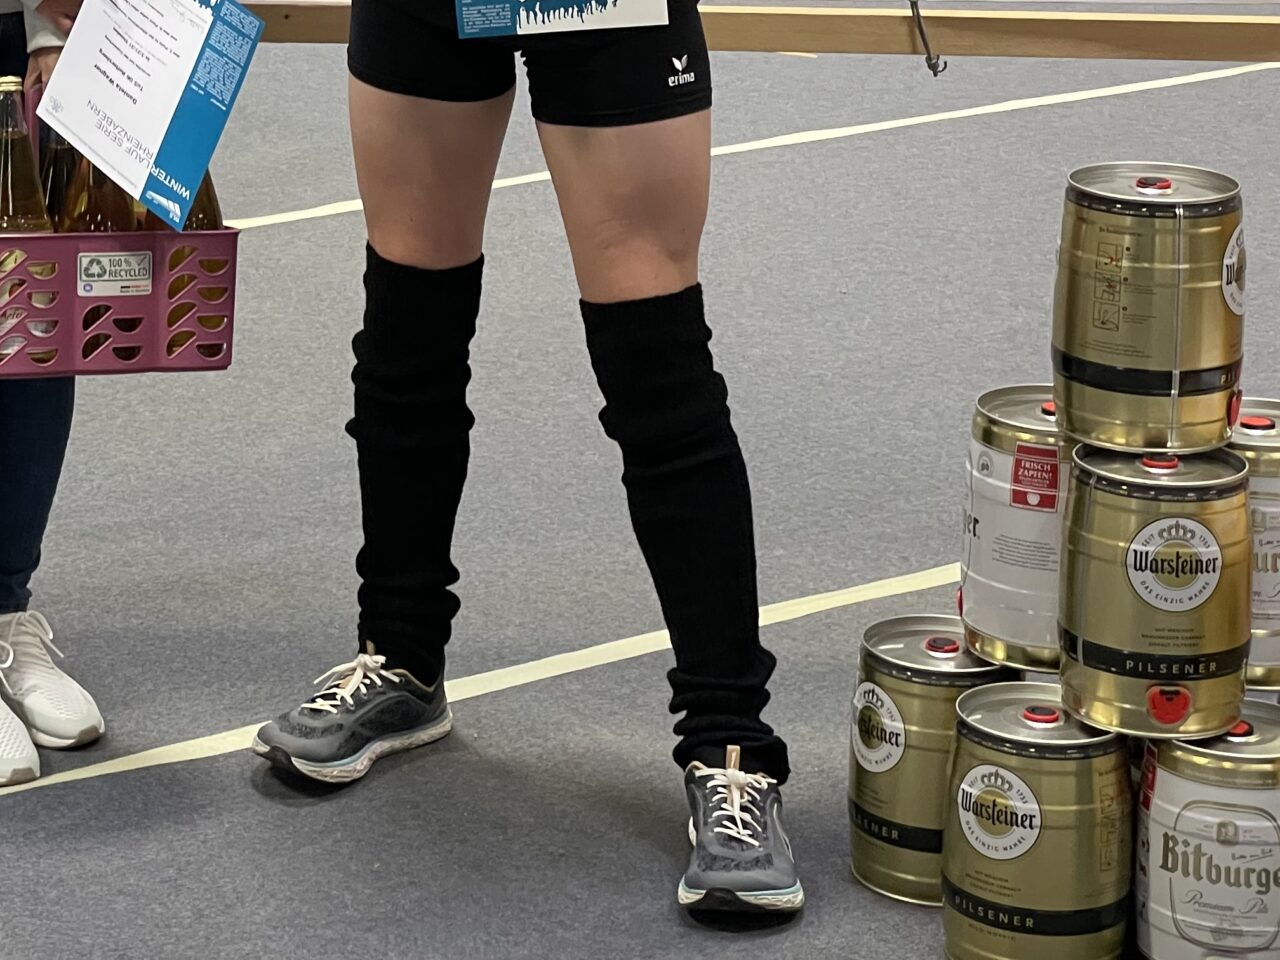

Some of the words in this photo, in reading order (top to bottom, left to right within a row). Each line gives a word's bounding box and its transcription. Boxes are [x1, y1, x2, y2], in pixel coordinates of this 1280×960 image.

[667, 72, 695, 87] erima
[86, 99, 154, 160] RHEINZABERN
[95, 118, 124, 148] SERIE
[124, 146, 151, 169] LAUF
[150, 162, 190, 201] WINTER
[108, 268, 148, 279] RECYCLED
[109, 258, 122, 268] 100
[1020, 460, 1051, 471] FRISCH
[1133, 549, 1219, 578] Warsteiner
[1140, 580, 1153, 595] DAS
[1154, 593, 1185, 604] EINZIG
[1125, 659, 1218, 675] PILSENER
[961, 787, 1037, 831] Warsteiner
[1159, 831, 1280, 896] Bitburge
[954, 895, 1035, 929] PILSENER
